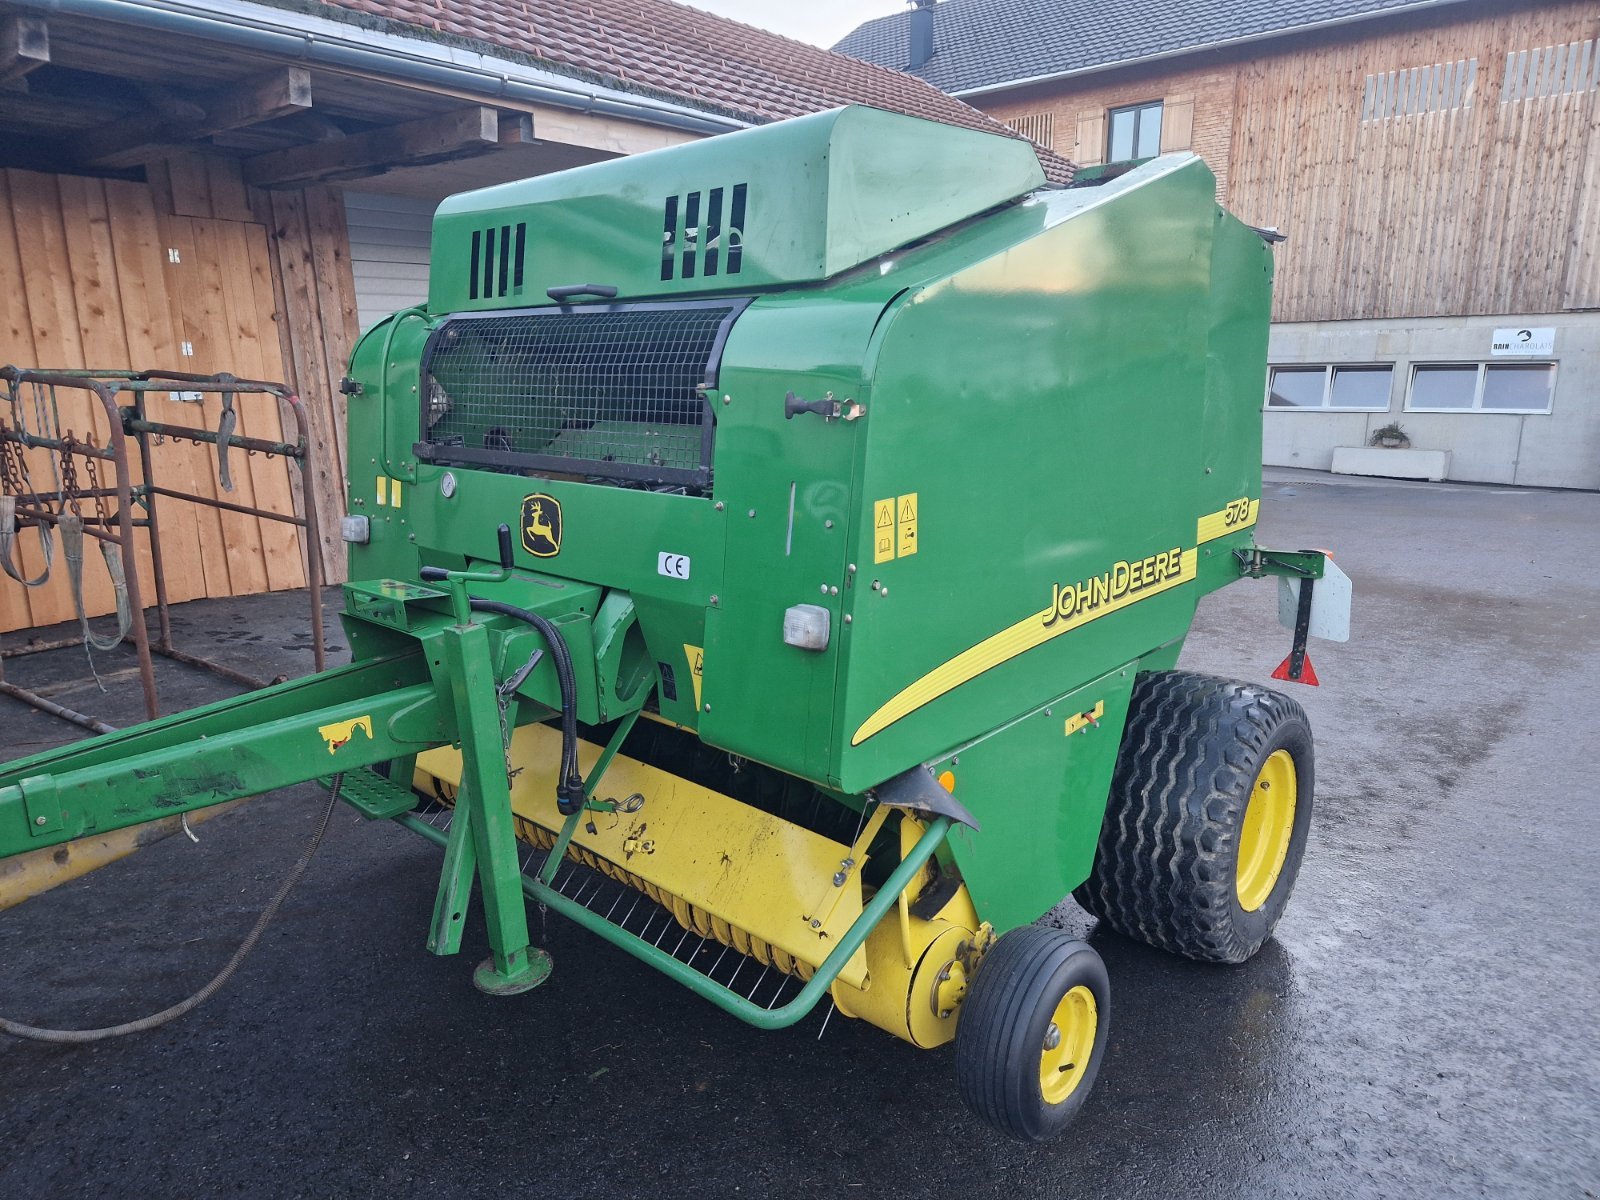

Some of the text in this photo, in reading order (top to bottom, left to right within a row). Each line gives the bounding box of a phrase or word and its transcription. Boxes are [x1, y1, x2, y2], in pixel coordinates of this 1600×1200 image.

[1225, 497, 1249, 526] 578
[665, 555, 684, 576] CE
[1042, 547, 1181, 626] JOHN DEERE
